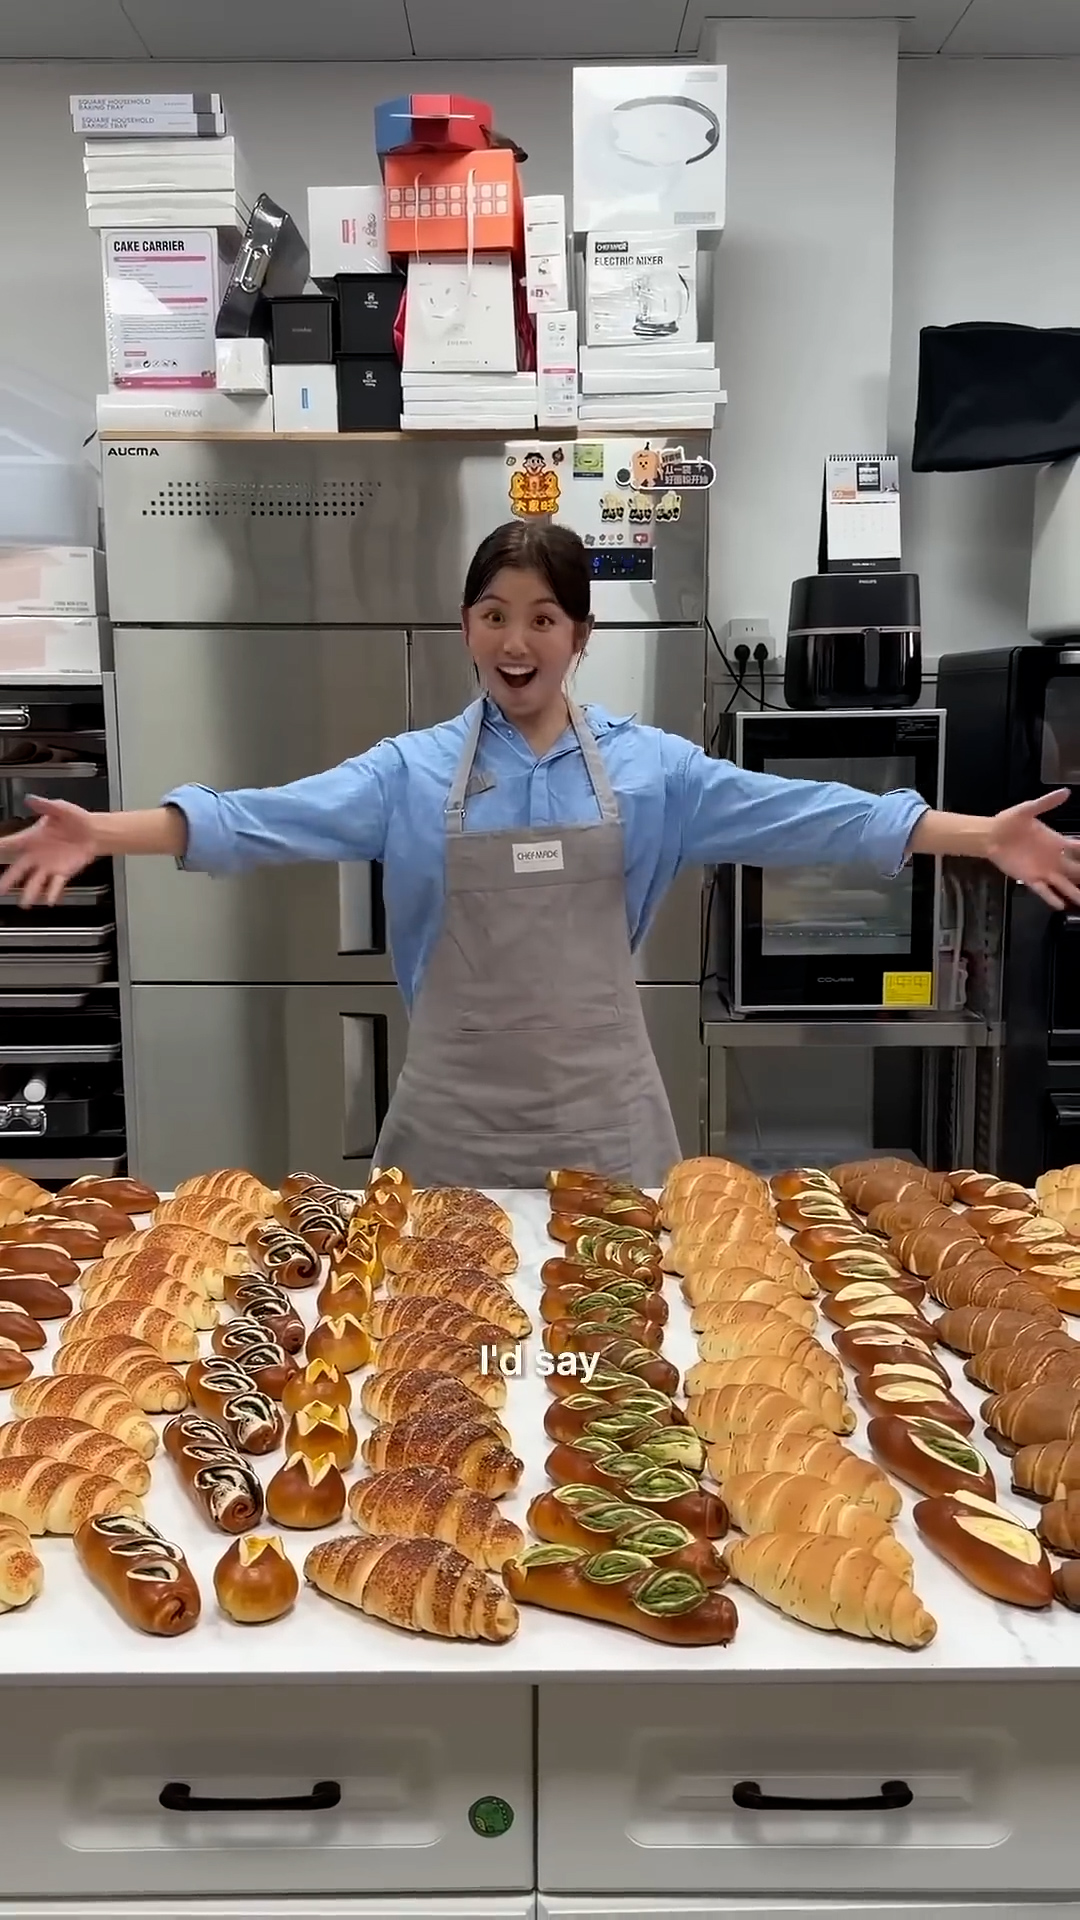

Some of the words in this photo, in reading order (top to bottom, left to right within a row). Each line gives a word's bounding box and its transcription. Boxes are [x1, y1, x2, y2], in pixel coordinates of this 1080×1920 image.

[113, 240, 140, 252] CAKE
[142, 240, 185, 252] CARRIER
[594, 256, 634, 266] ELECTRIC
[636, 255, 664, 265] MIXER
[107, 447, 160, 457] AUCMA
[516, 850, 559, 860] CHEFMADE
